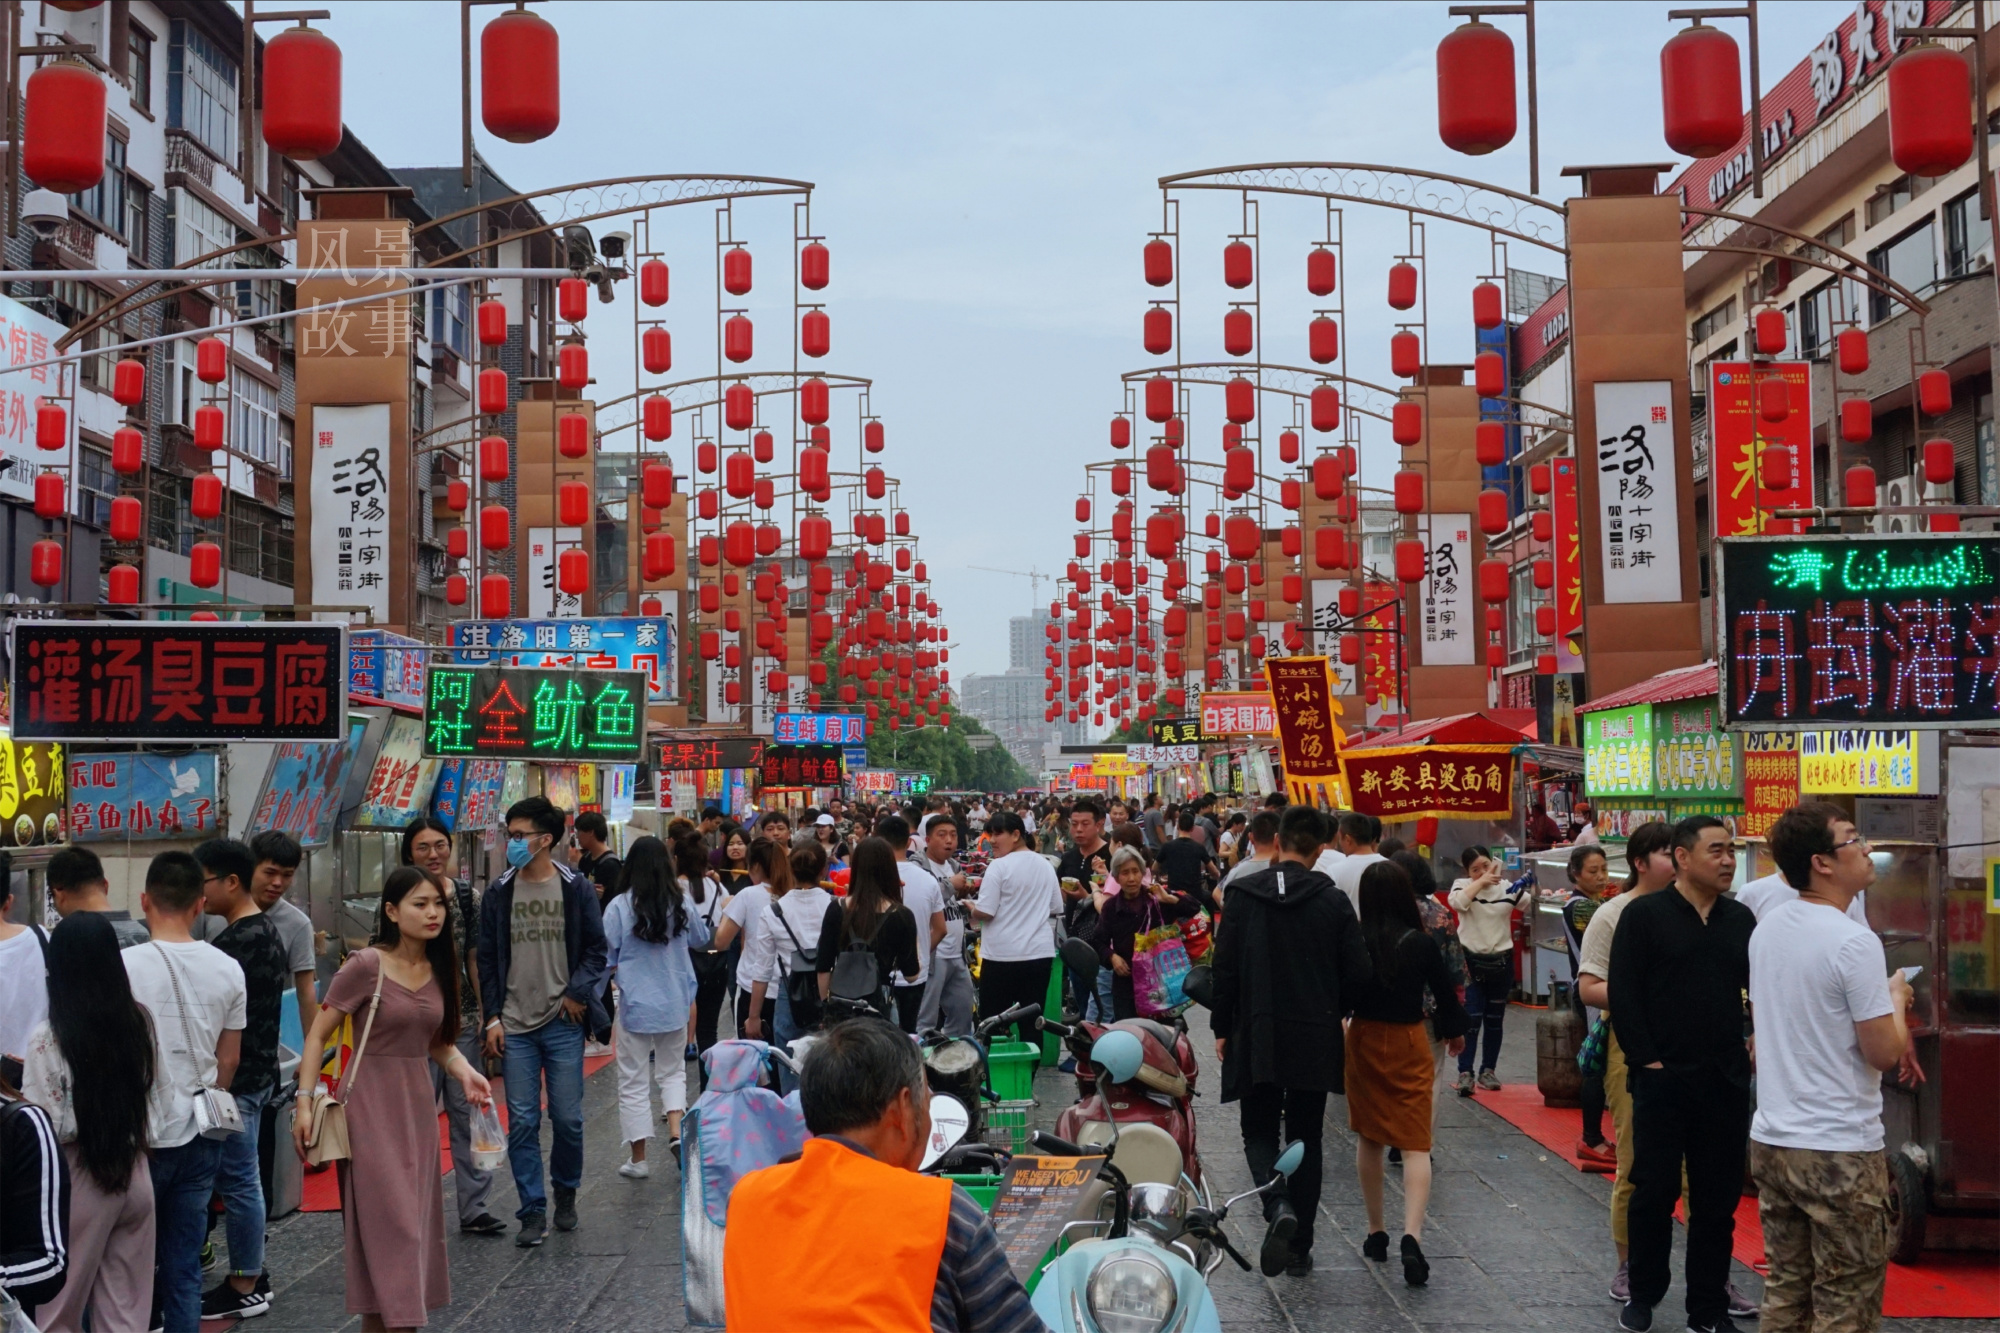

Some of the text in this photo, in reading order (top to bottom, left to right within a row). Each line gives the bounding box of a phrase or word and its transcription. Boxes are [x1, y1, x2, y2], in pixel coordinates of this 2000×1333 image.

[501, 623, 659, 649] 洛阳第一家
[28, 638, 328, 726] 灌汤臭豆腐
[428, 671, 475, 753] 阿杜
[477, 679, 638, 749] 全鱿鱼
[777, 716, 863, 742] 生蚝扇贝
[1294, 682, 1325, 757] 小碗汤
[855, 773, 894, 790] 炒酸奶
[1358, 761, 1502, 798] 新安县烫面角
[71, 798, 214, 836] 章鱼小丸子
[1382, 795, 1486, 809] 洛阳十大小吃之一
[1015, 1169, 1091, 1187] WE NEED YOU
